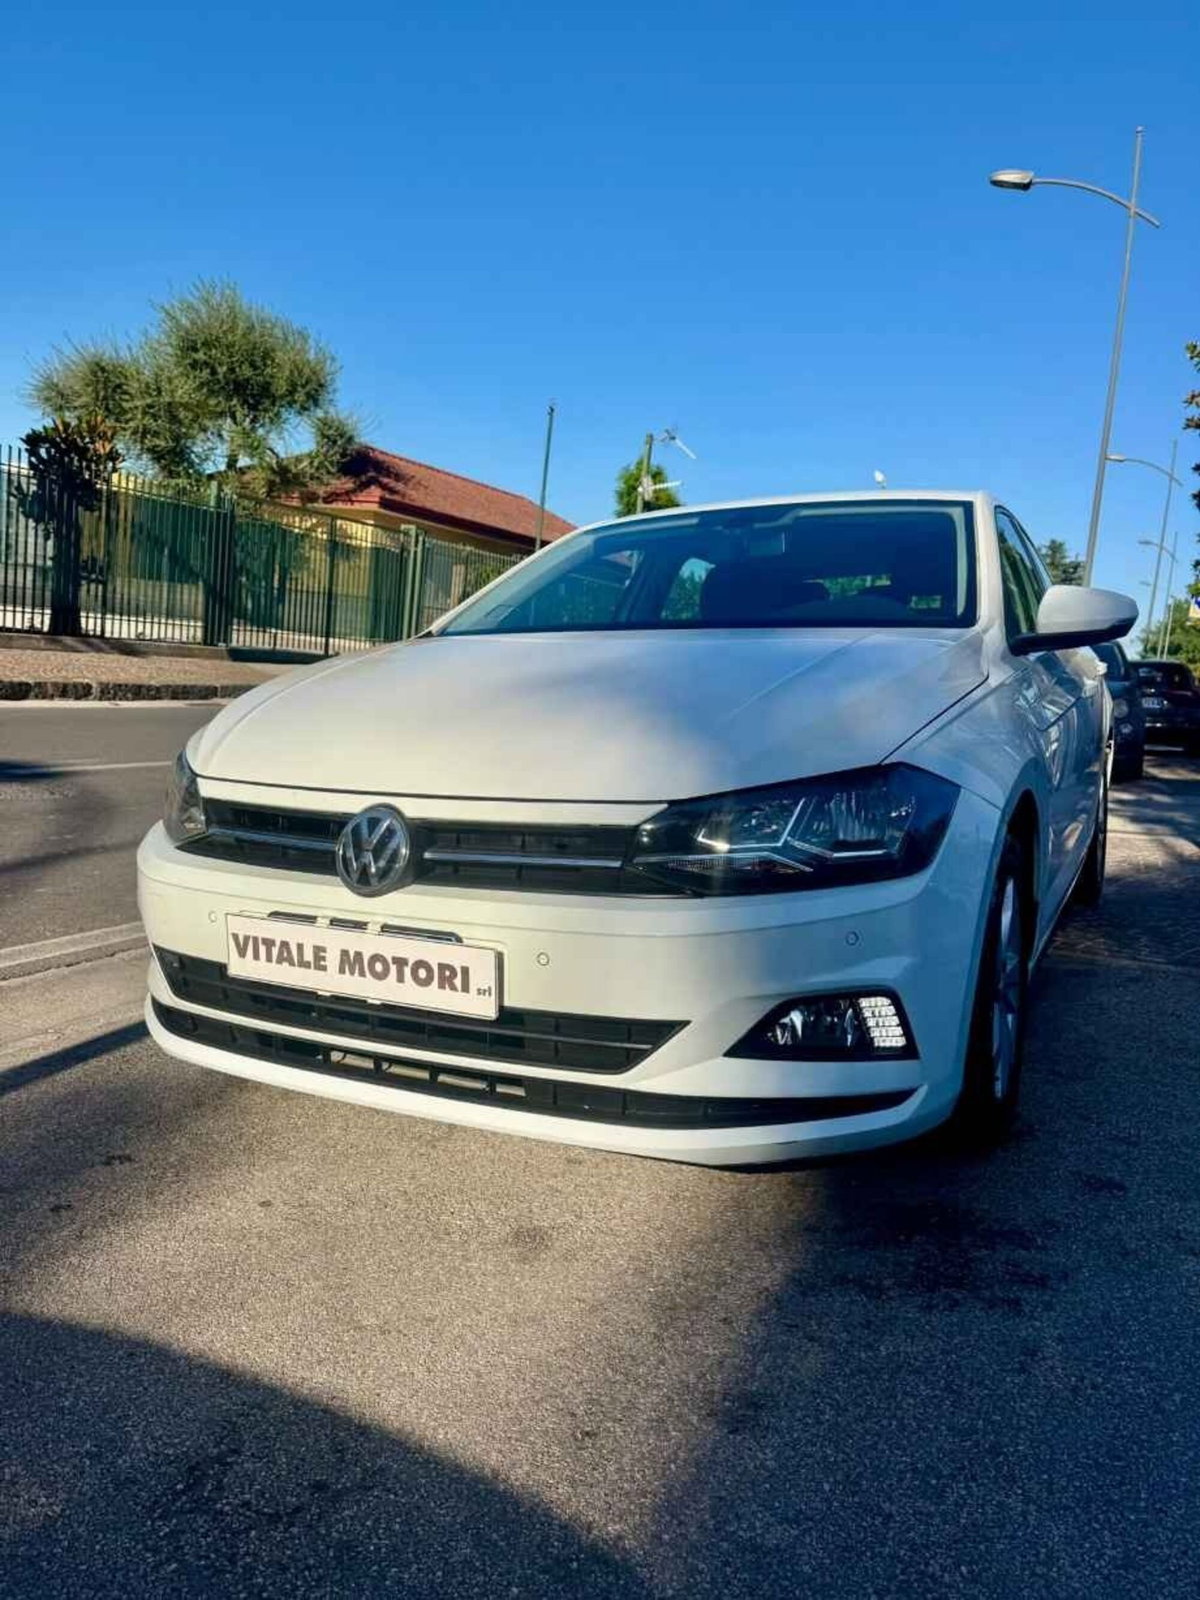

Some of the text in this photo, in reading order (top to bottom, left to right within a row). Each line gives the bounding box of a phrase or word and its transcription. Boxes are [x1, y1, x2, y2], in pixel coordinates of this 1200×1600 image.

[231, 932, 492, 998] VITALE MOTORI srl
